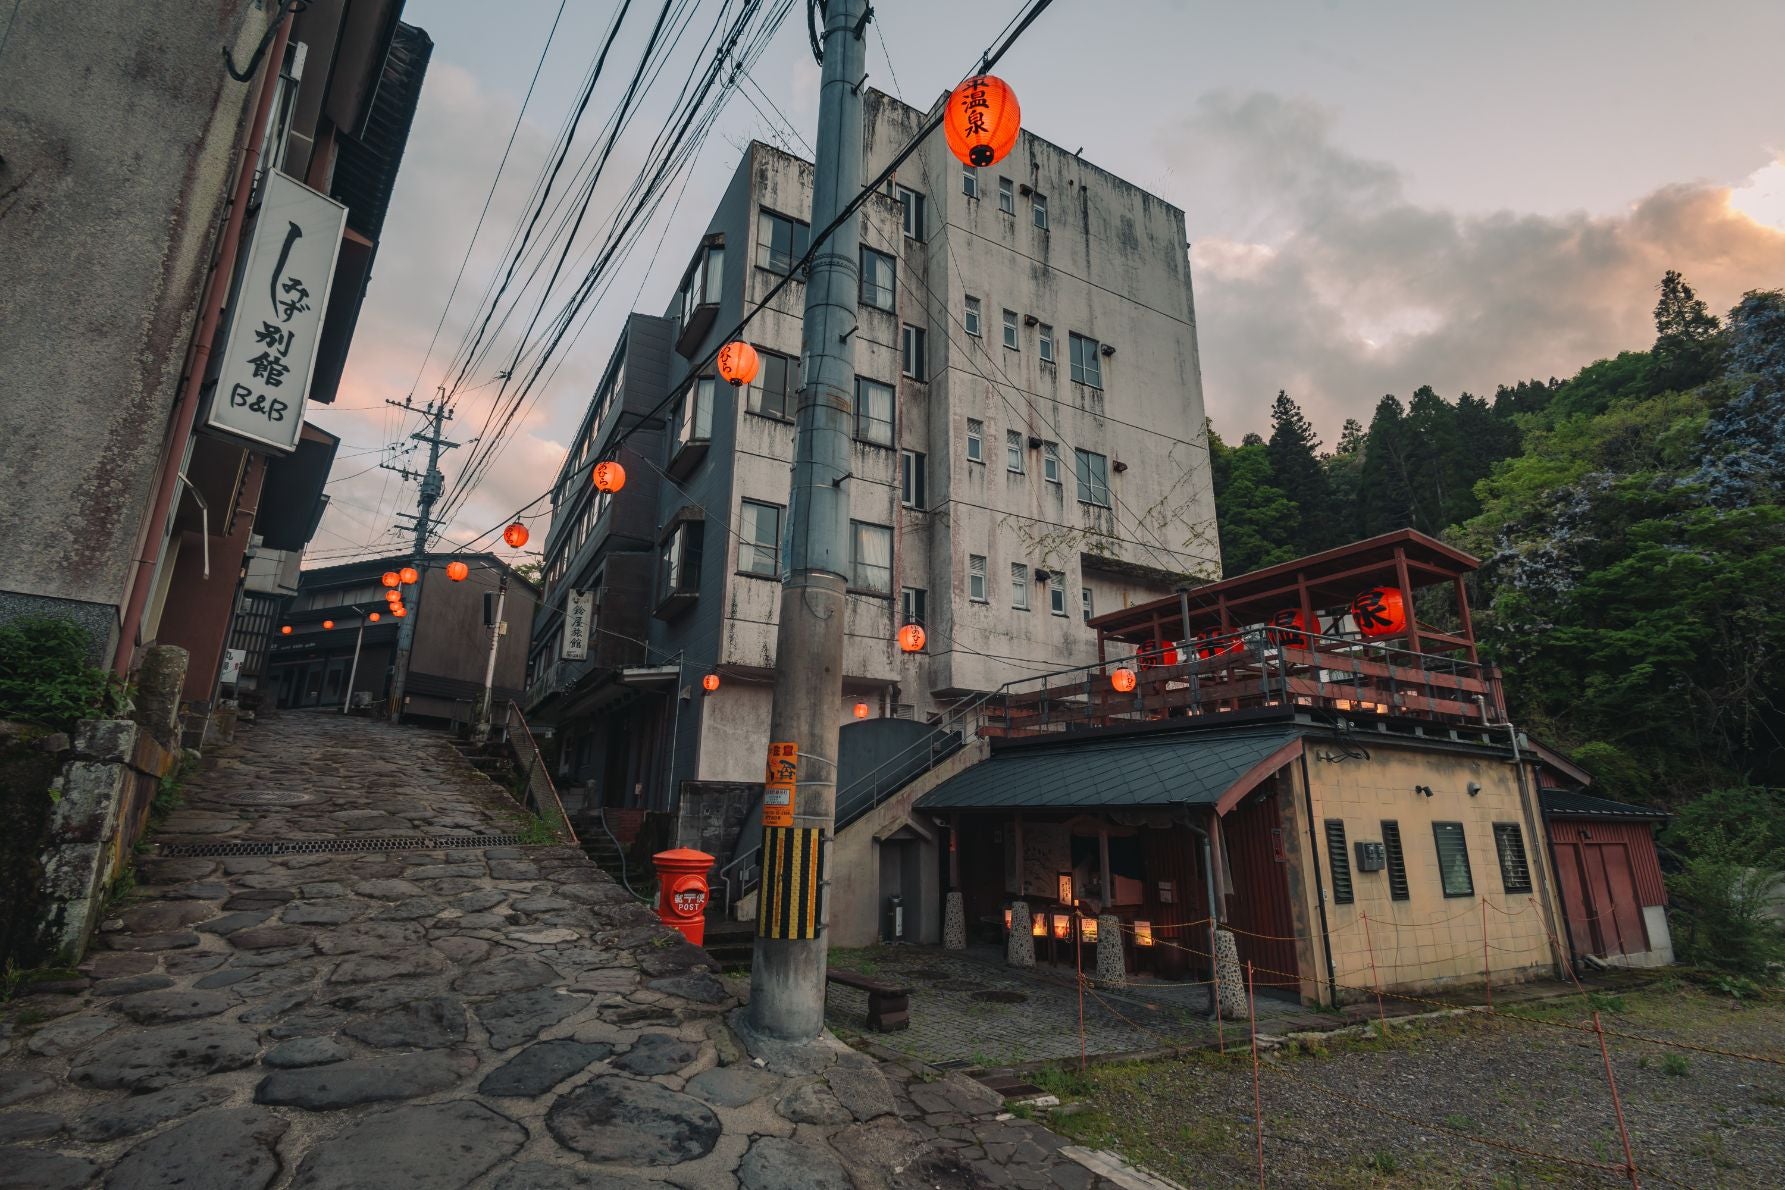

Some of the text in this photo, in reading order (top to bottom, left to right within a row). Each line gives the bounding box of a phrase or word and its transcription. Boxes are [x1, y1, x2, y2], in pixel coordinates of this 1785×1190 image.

[246, 221, 311, 388] しみず別館
[719, 345, 732, 374] のひら
[230, 383, 288, 421] B&B
